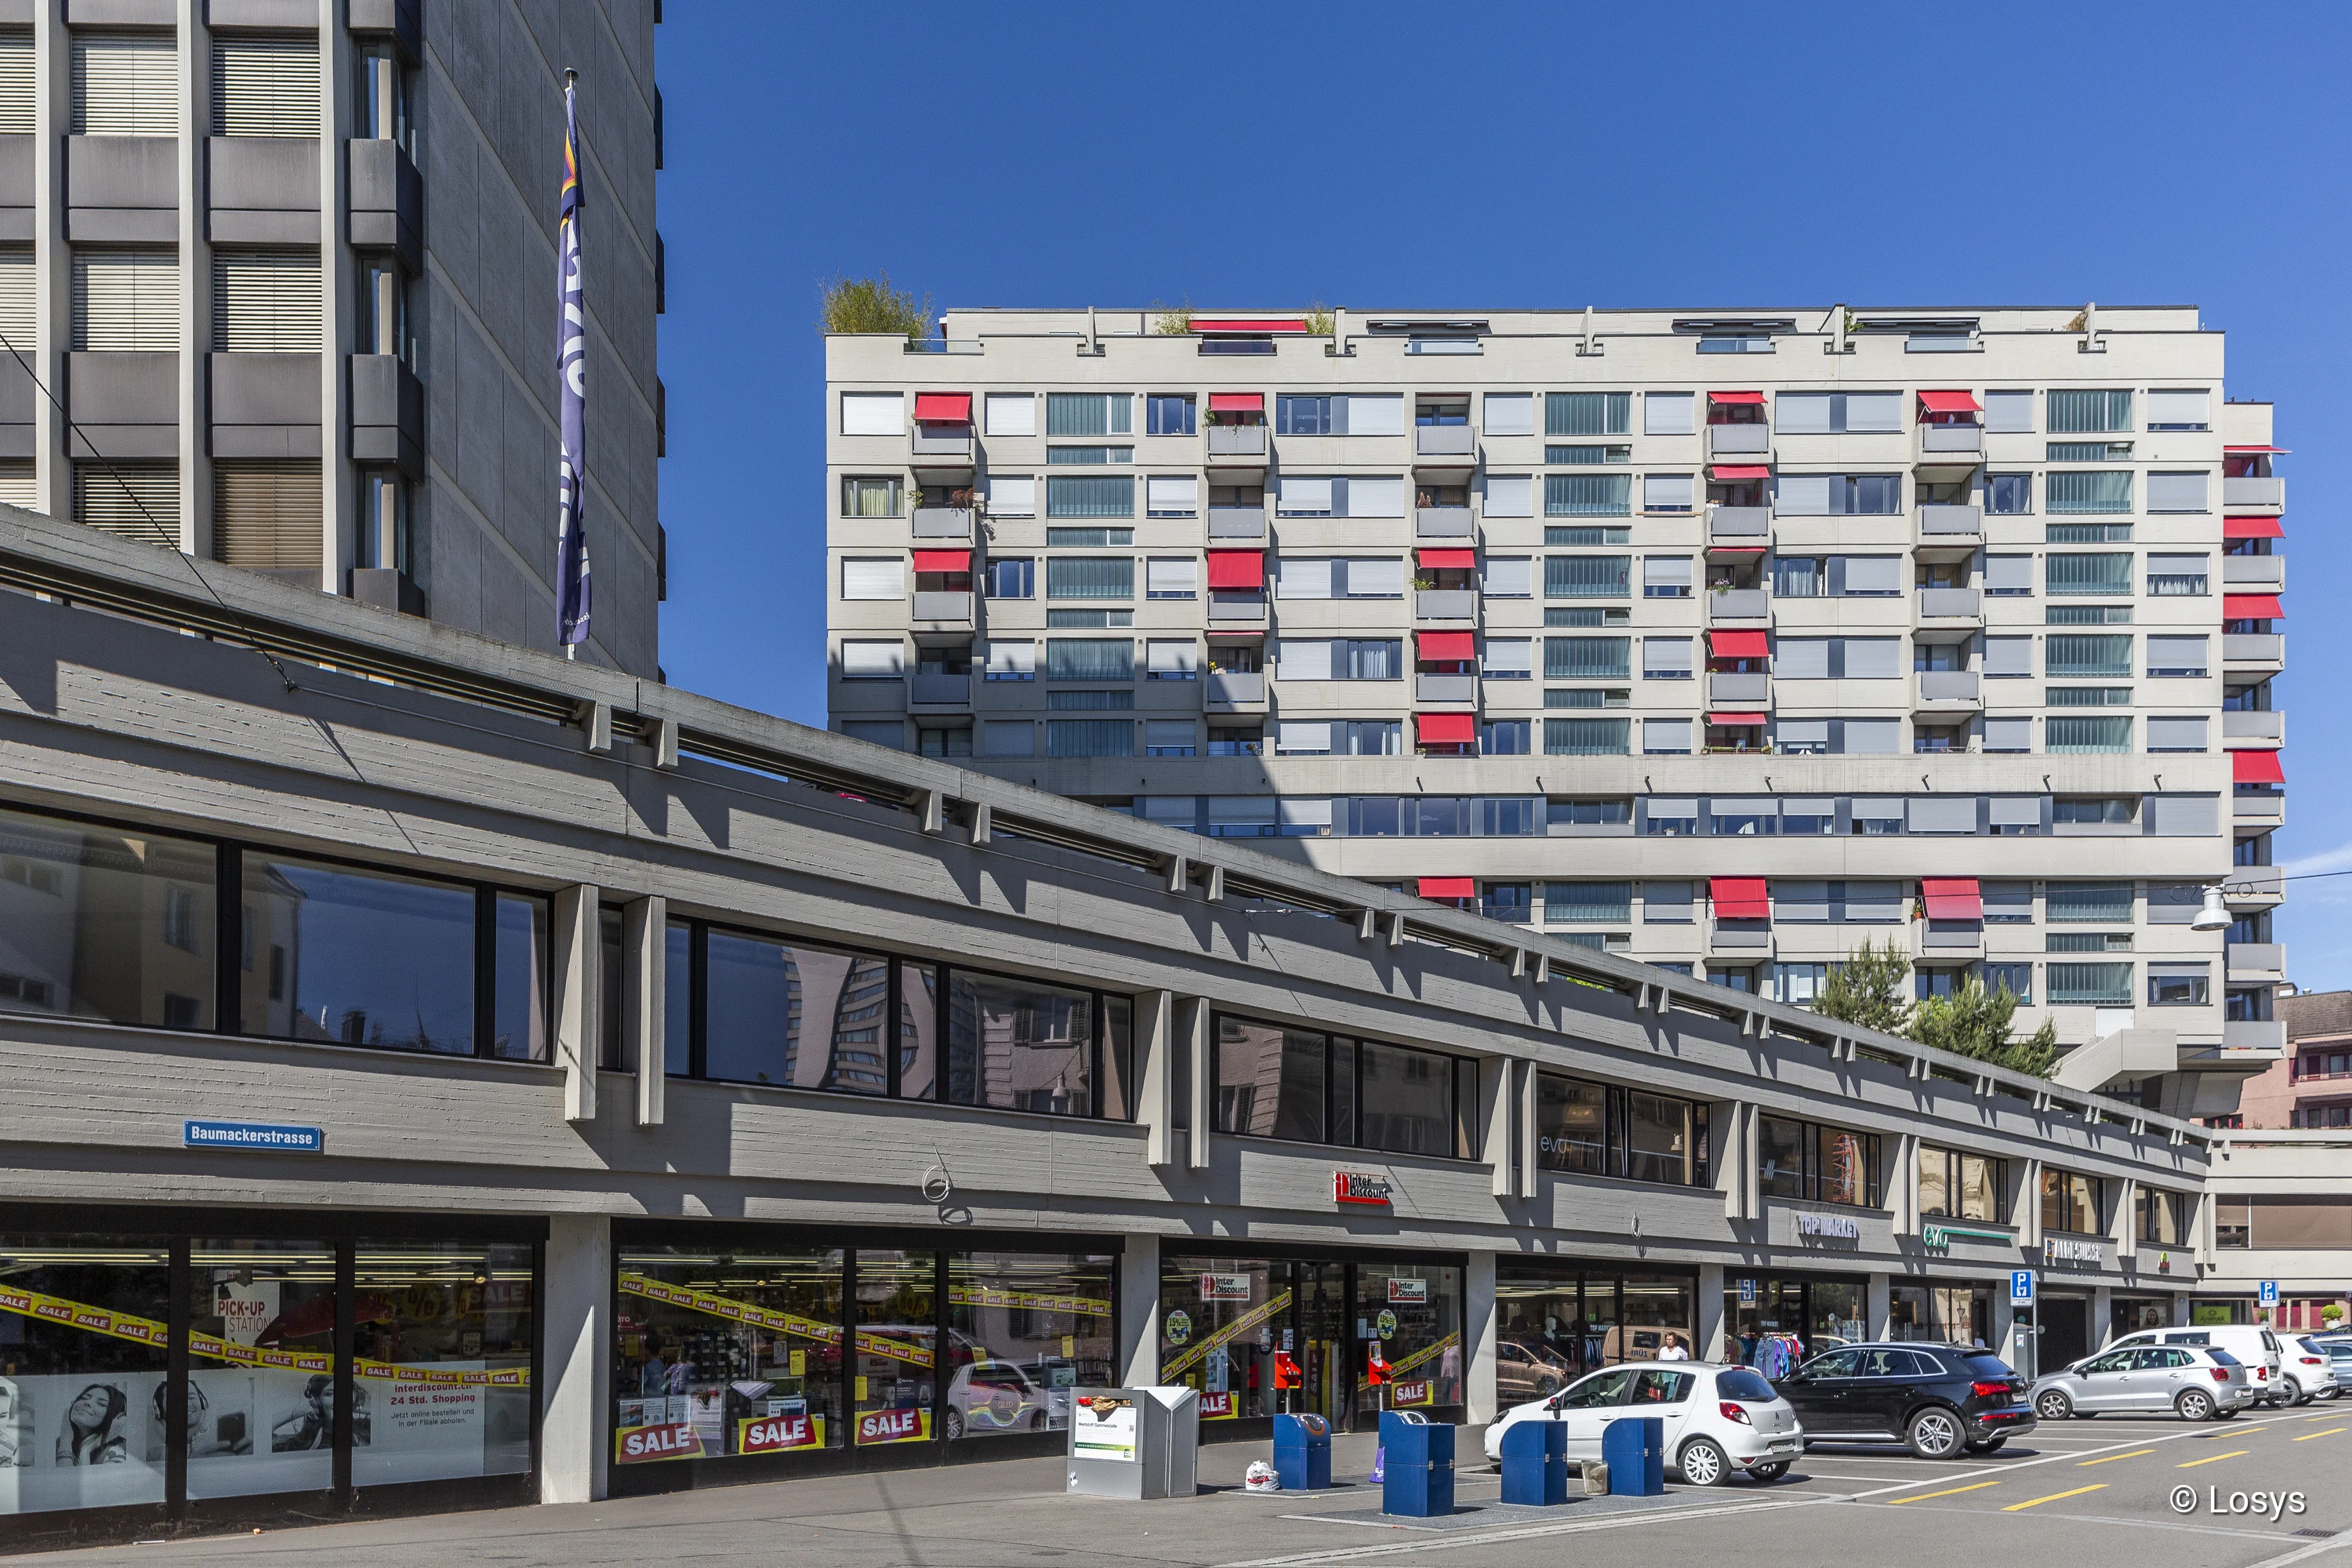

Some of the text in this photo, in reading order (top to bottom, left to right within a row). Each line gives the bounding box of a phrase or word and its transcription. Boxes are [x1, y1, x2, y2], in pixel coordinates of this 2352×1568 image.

[191, 1126, 313, 1145] Baumackerstrasse
[1348, 1174, 1371, 1185] Inter
[1349, 1185, 1388, 1199] Discount
[1799, 1214, 1858, 1238] TOP MARKET
[1216, 1276, 1234, 1285] Inter
[2017, 1273, 2026, 1286] P
[2265, 1282, 2272, 1292] P
[470, 1285, 523, 1302] SALE
[1216, 1285, 1248, 1294] Discount
[218, 1301, 265, 1316] PICK-UP
[622, 1281, 642, 1290] SALE
[648, 1288, 667, 1297] SALE
[673, 1294, 691, 1304] SALE
[697, 1301, 716, 1309] SALE
[720, 1307, 739, 1316] SALE
[745, 1312, 762, 1321] SALE
[767, 1318, 784, 1327] SALE
[789, 1323, 806, 1332] SALE
[811, 1329, 828, 1338] SALE
[38, 1305, 71, 1319] SALE
[78, 1315, 108, 1327] SALE
[118, 1324, 147, 1337] SALE
[154, 1334, 167, 1343] SA
[229, 1317, 270, 1333] STATION
[1168, 1317, 1181, 1327] 15%
[1380, 1315, 1389, 1324] 15%
[192, 1341, 325, 1369] SALE SALE SALE SALE
[367, 1367, 391, 1376] SALE
[493, 1374, 517, 1382] SALE
[408, 1396, 428, 1404] Std.
[432, 1394, 475, 1403] Shopping
[1396, 1384, 1423, 1401] SALE
[1200, 1395, 1226, 1413] ALE
[749, 1419, 806, 1444] SALE
[863, 1413, 913, 1436] SALE
[626, 1428, 690, 1455] SALE
